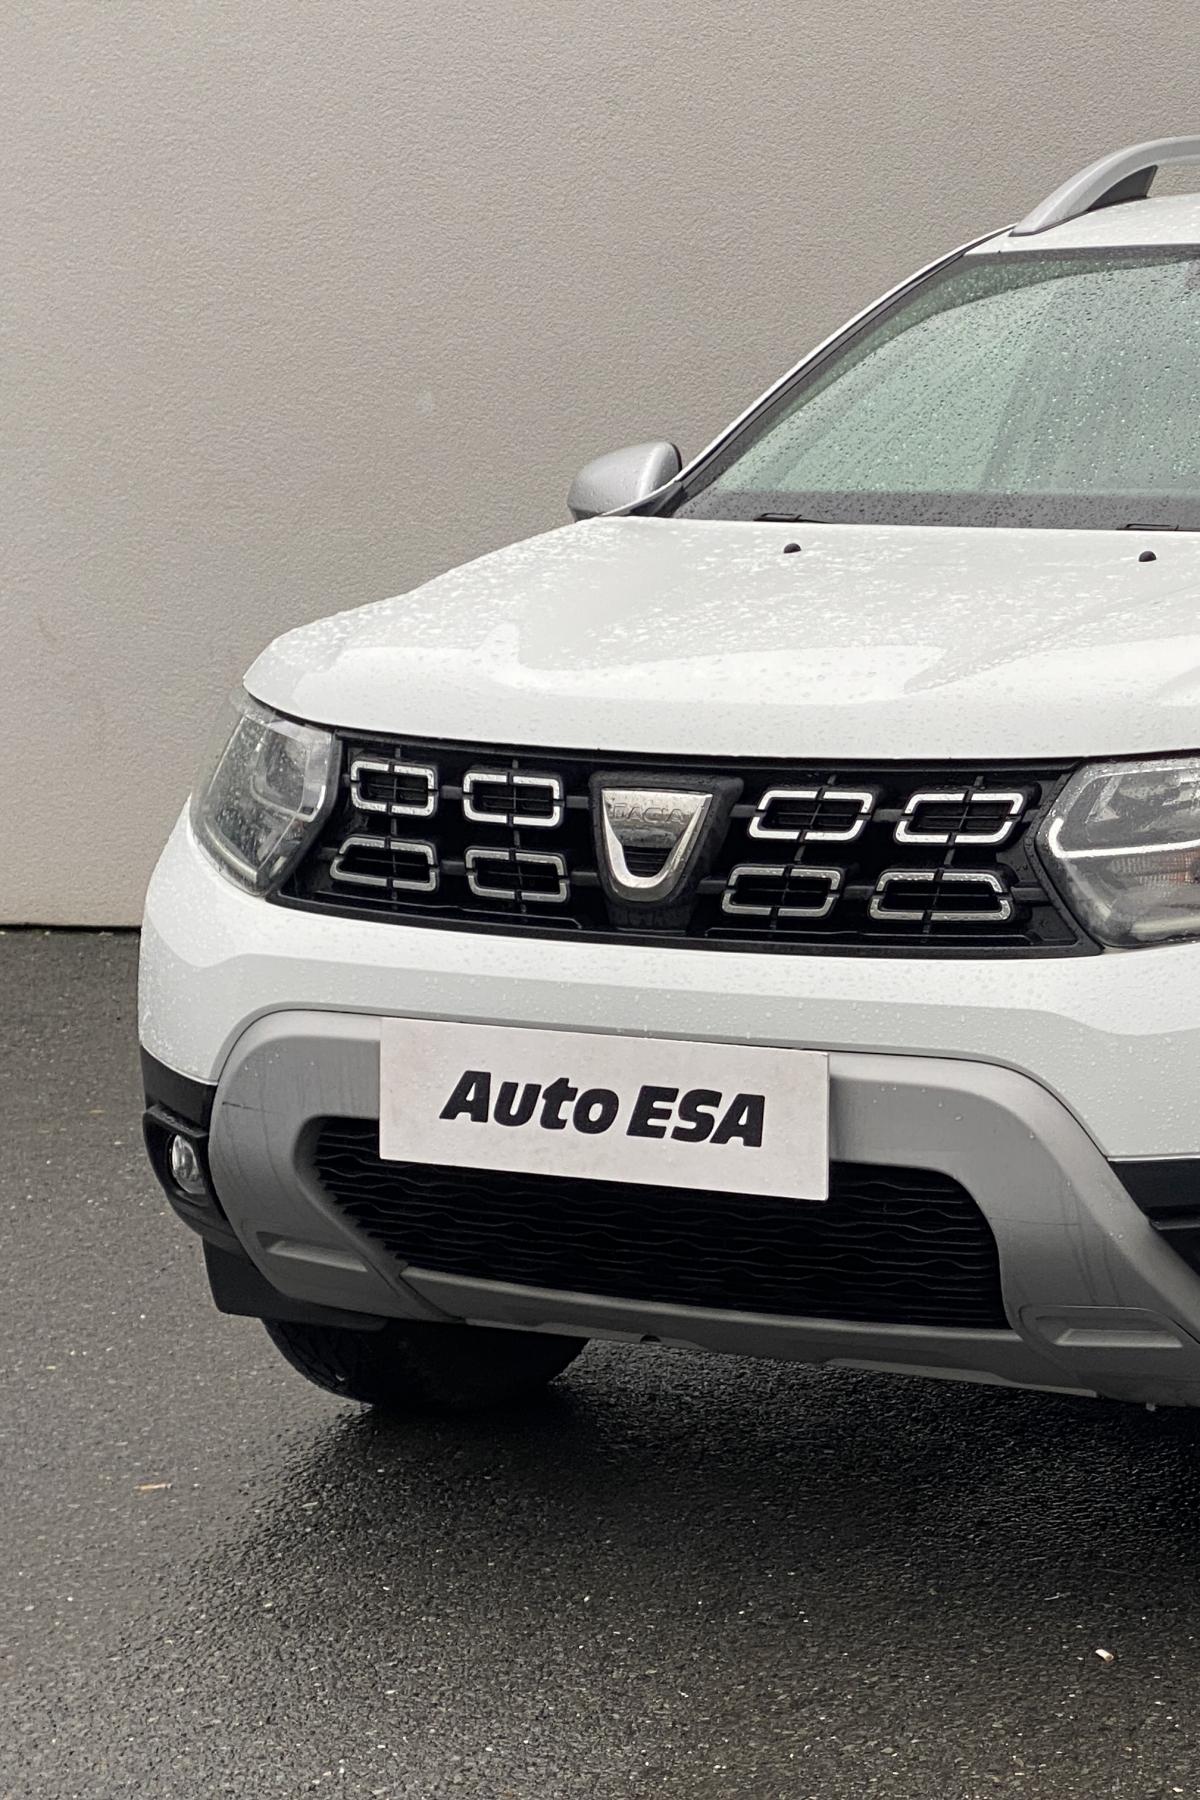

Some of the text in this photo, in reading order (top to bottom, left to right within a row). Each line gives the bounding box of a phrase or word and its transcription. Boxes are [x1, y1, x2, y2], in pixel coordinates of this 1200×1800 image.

[611, 803, 684, 825] DACIA
[439, 1070, 765, 1147] Auto ESA
